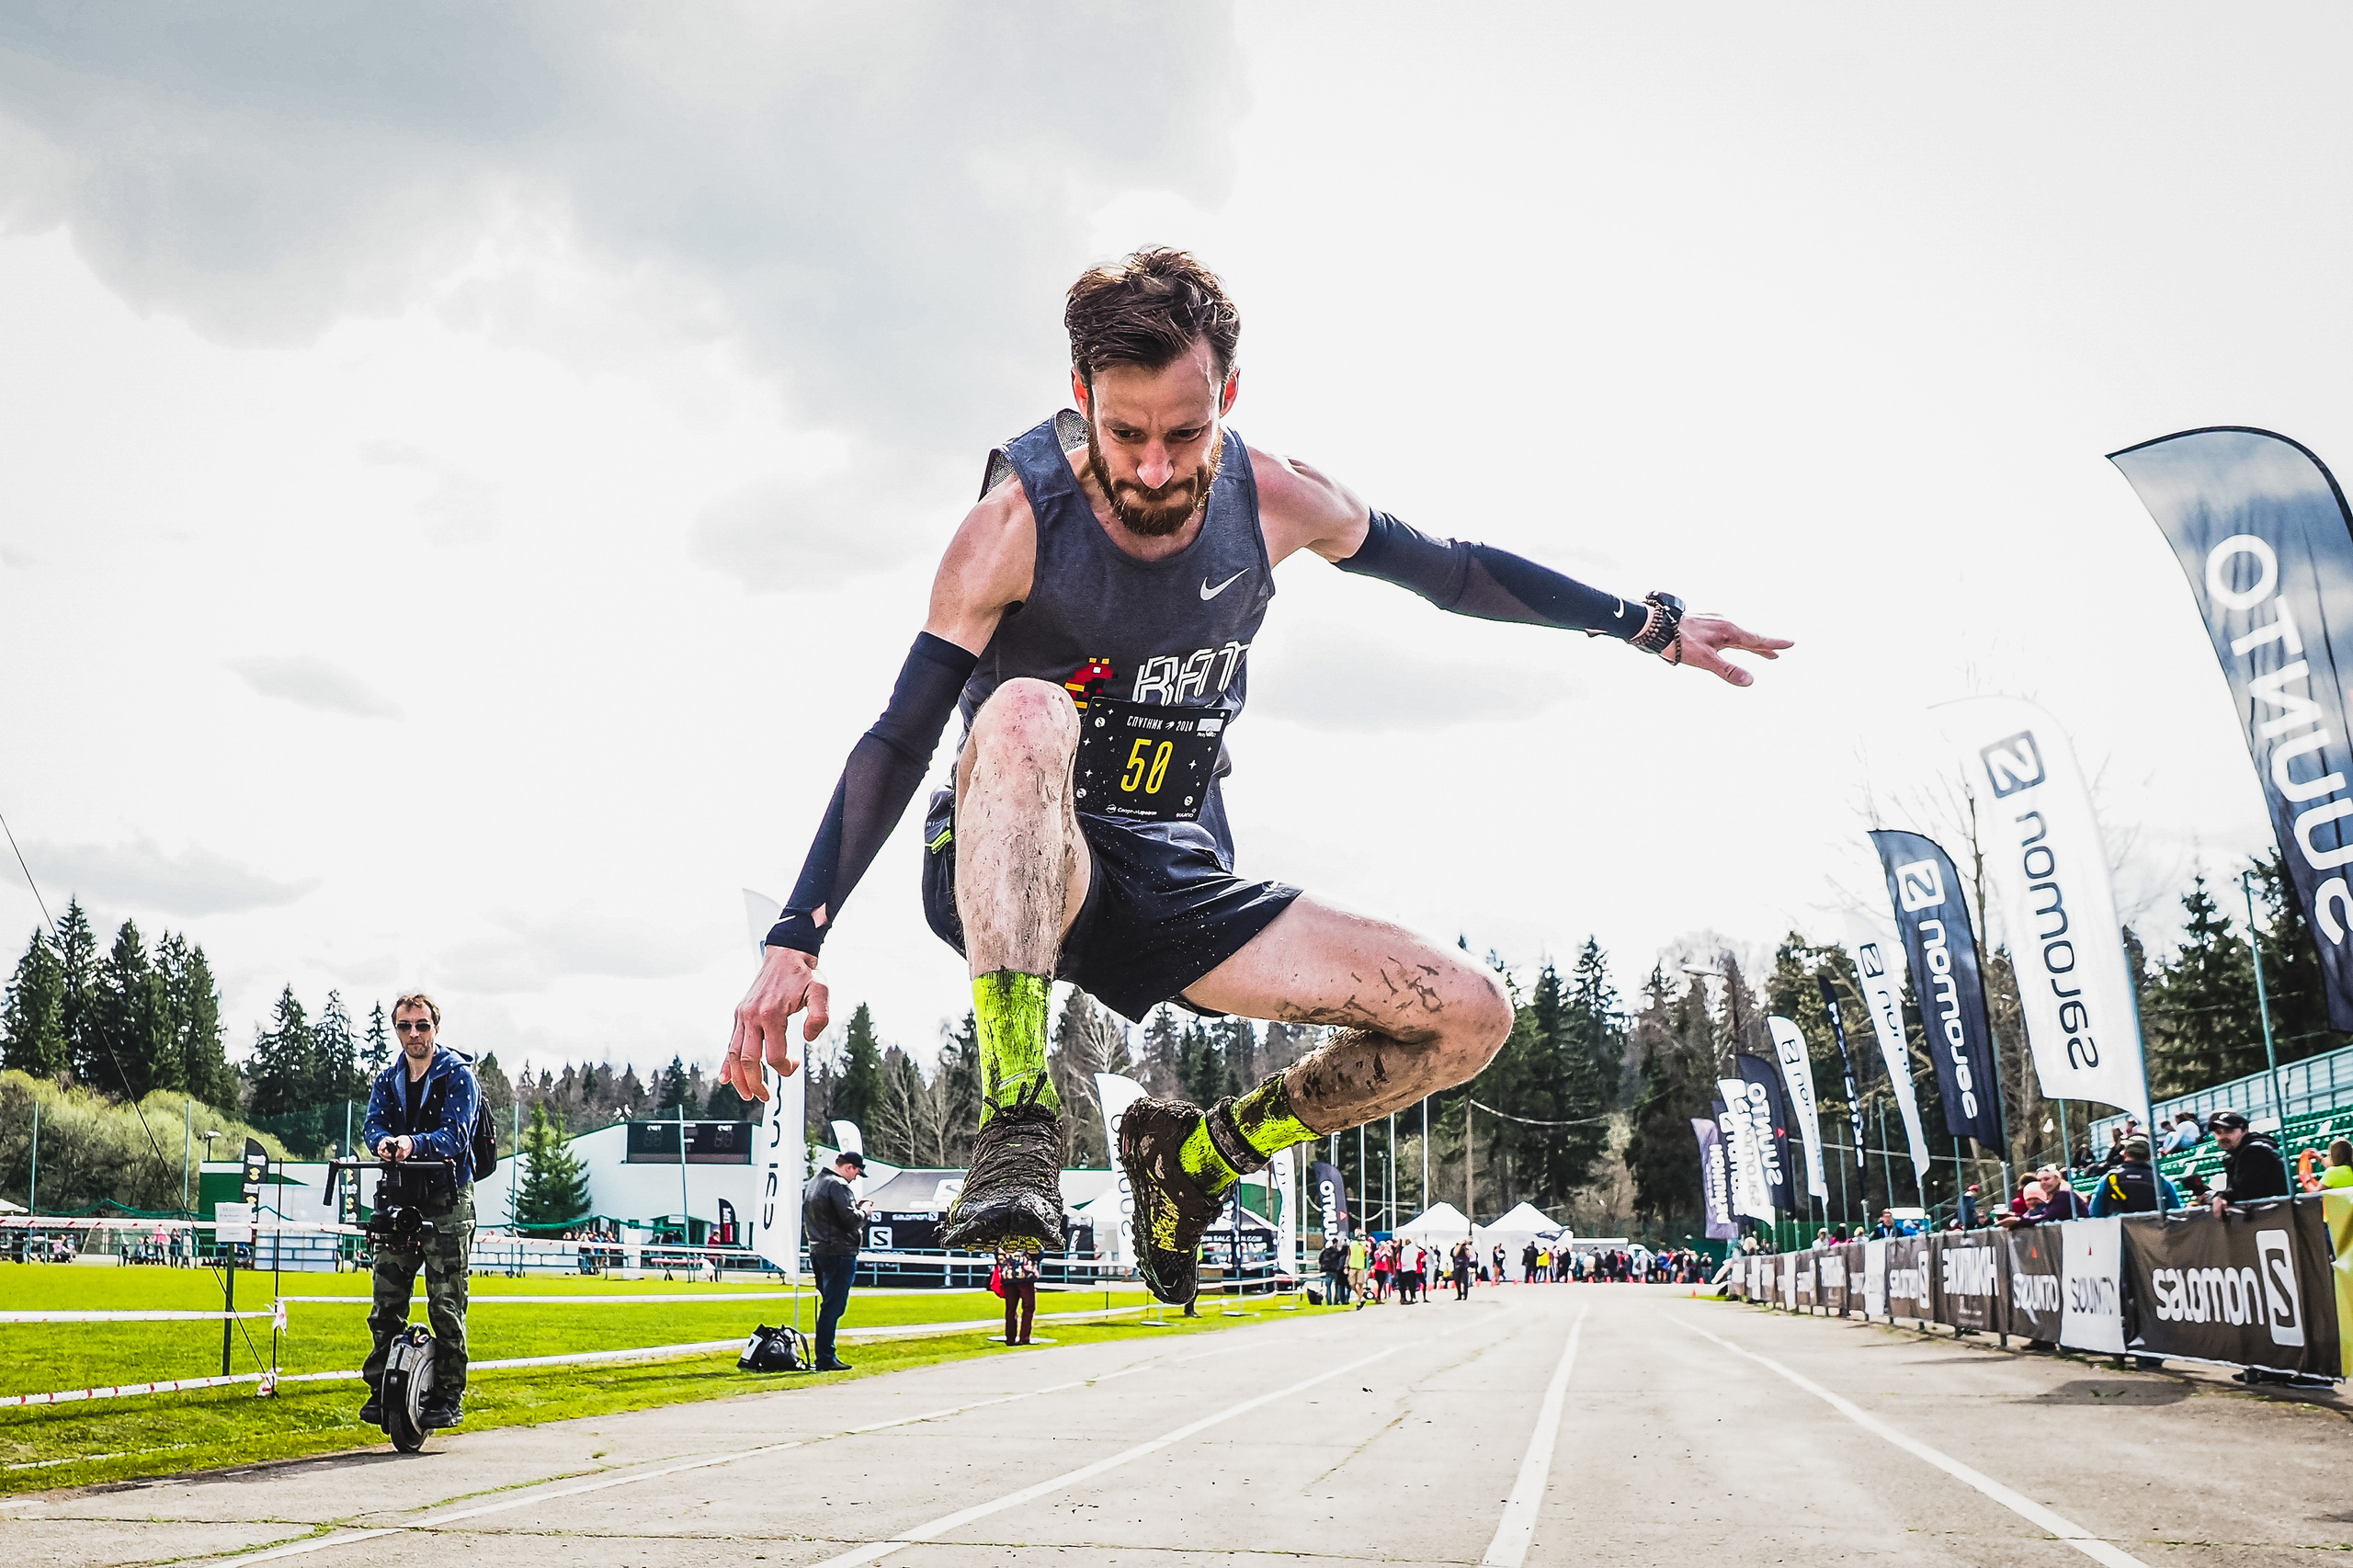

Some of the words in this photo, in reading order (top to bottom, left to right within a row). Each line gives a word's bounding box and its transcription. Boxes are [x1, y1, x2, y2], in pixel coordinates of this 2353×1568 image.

[1127, 715, 1164, 730] СПУТНИК
[1120, 738, 1174, 794] 50
[2153, 1267, 2265, 1325] salomon
